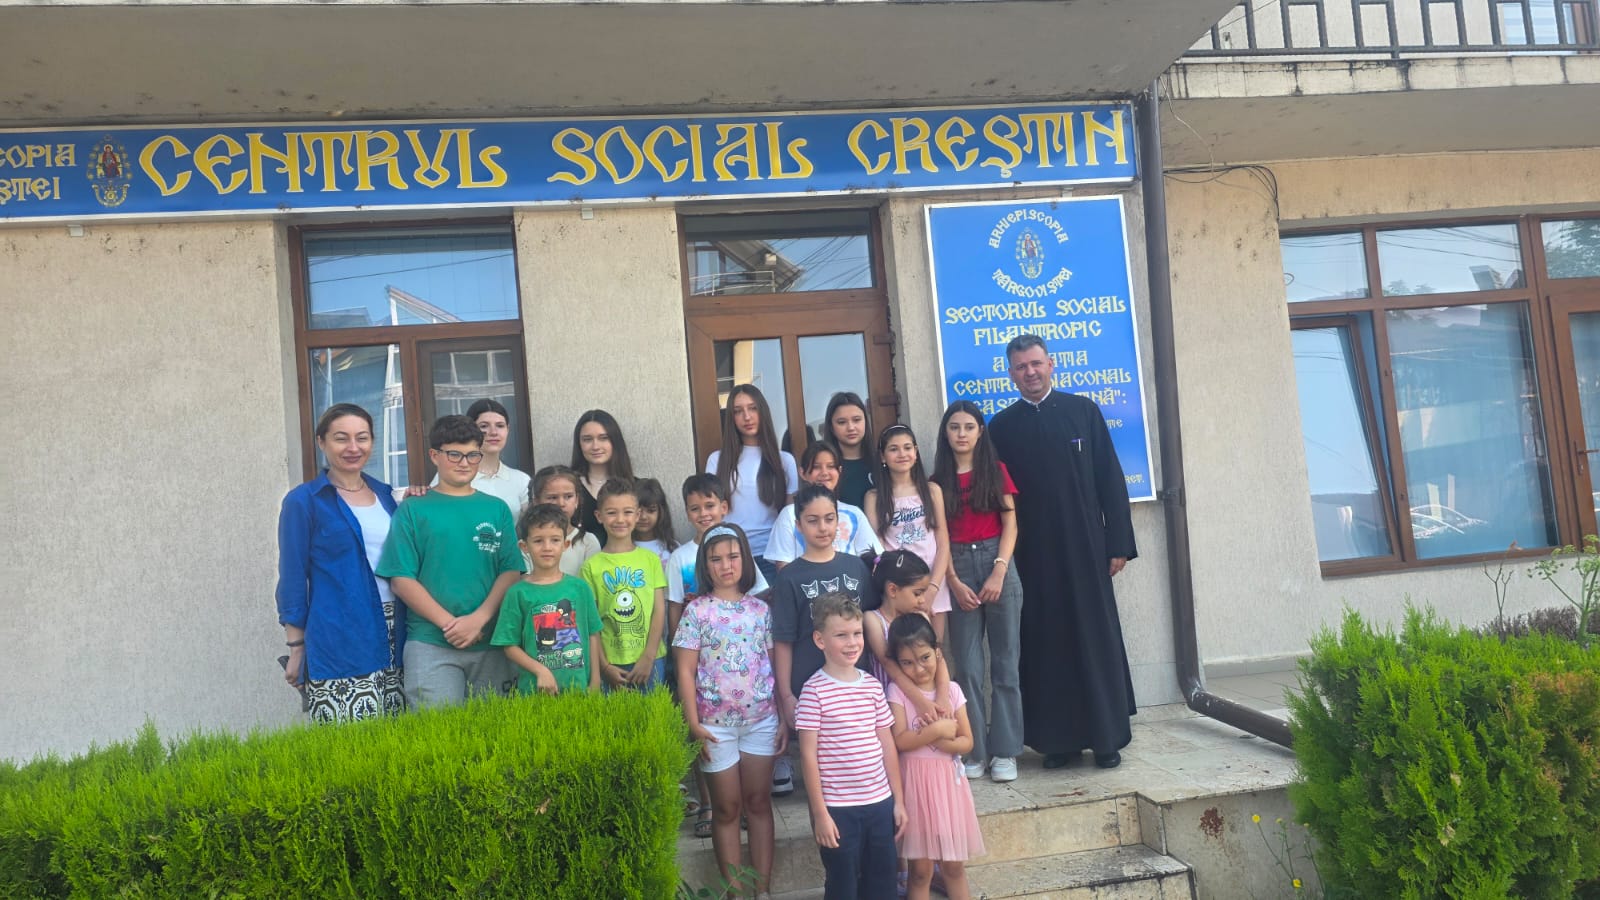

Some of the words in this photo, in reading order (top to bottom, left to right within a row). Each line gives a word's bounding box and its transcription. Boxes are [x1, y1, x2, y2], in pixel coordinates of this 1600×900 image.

[546, 122, 814, 186] SOCIAL
[988, 209, 1070, 249] ARHIEPISCOPIA
[1056, 295, 1127, 316] SOCIAL
[973, 320, 1102, 346] FILANTROPIC
[1049, 368, 1132, 389] IACONAL
